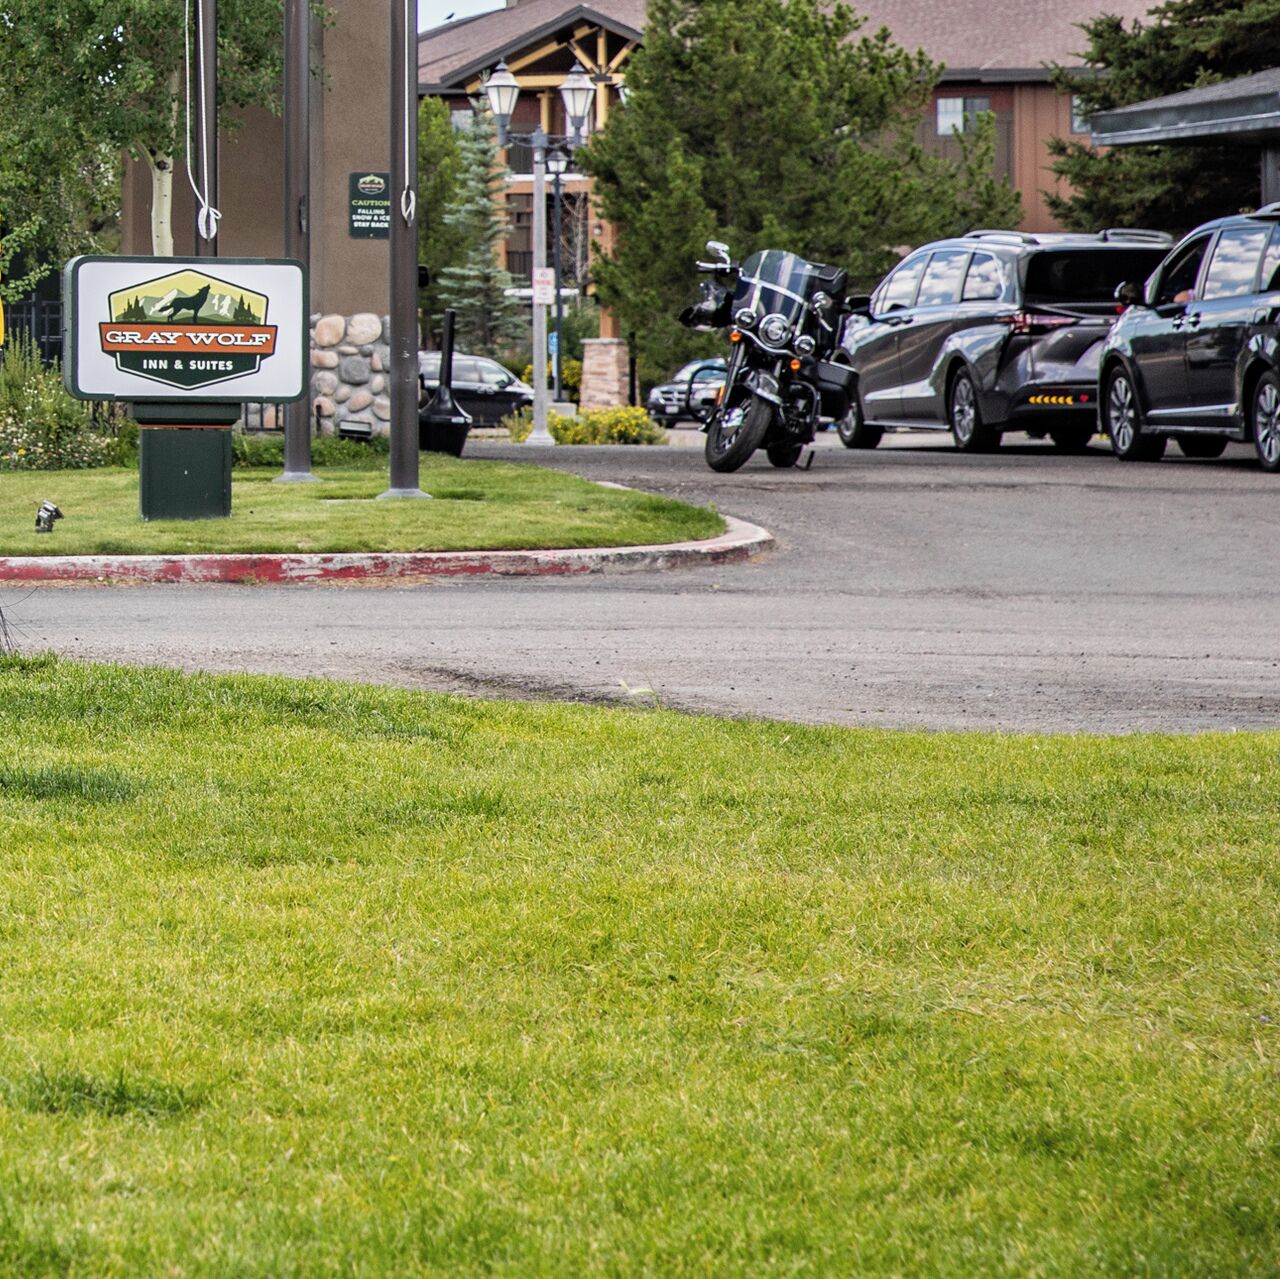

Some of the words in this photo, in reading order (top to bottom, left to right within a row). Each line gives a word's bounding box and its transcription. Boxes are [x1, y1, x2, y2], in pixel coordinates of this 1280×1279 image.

[351, 199, 390, 207] CAUTION
[105, 330, 183, 344] GRAY
[185, 332, 271, 346] WOLF
[143, 359, 168, 370] INN
[173, 359, 184, 370] &
[189, 359, 233, 371] SUITES
